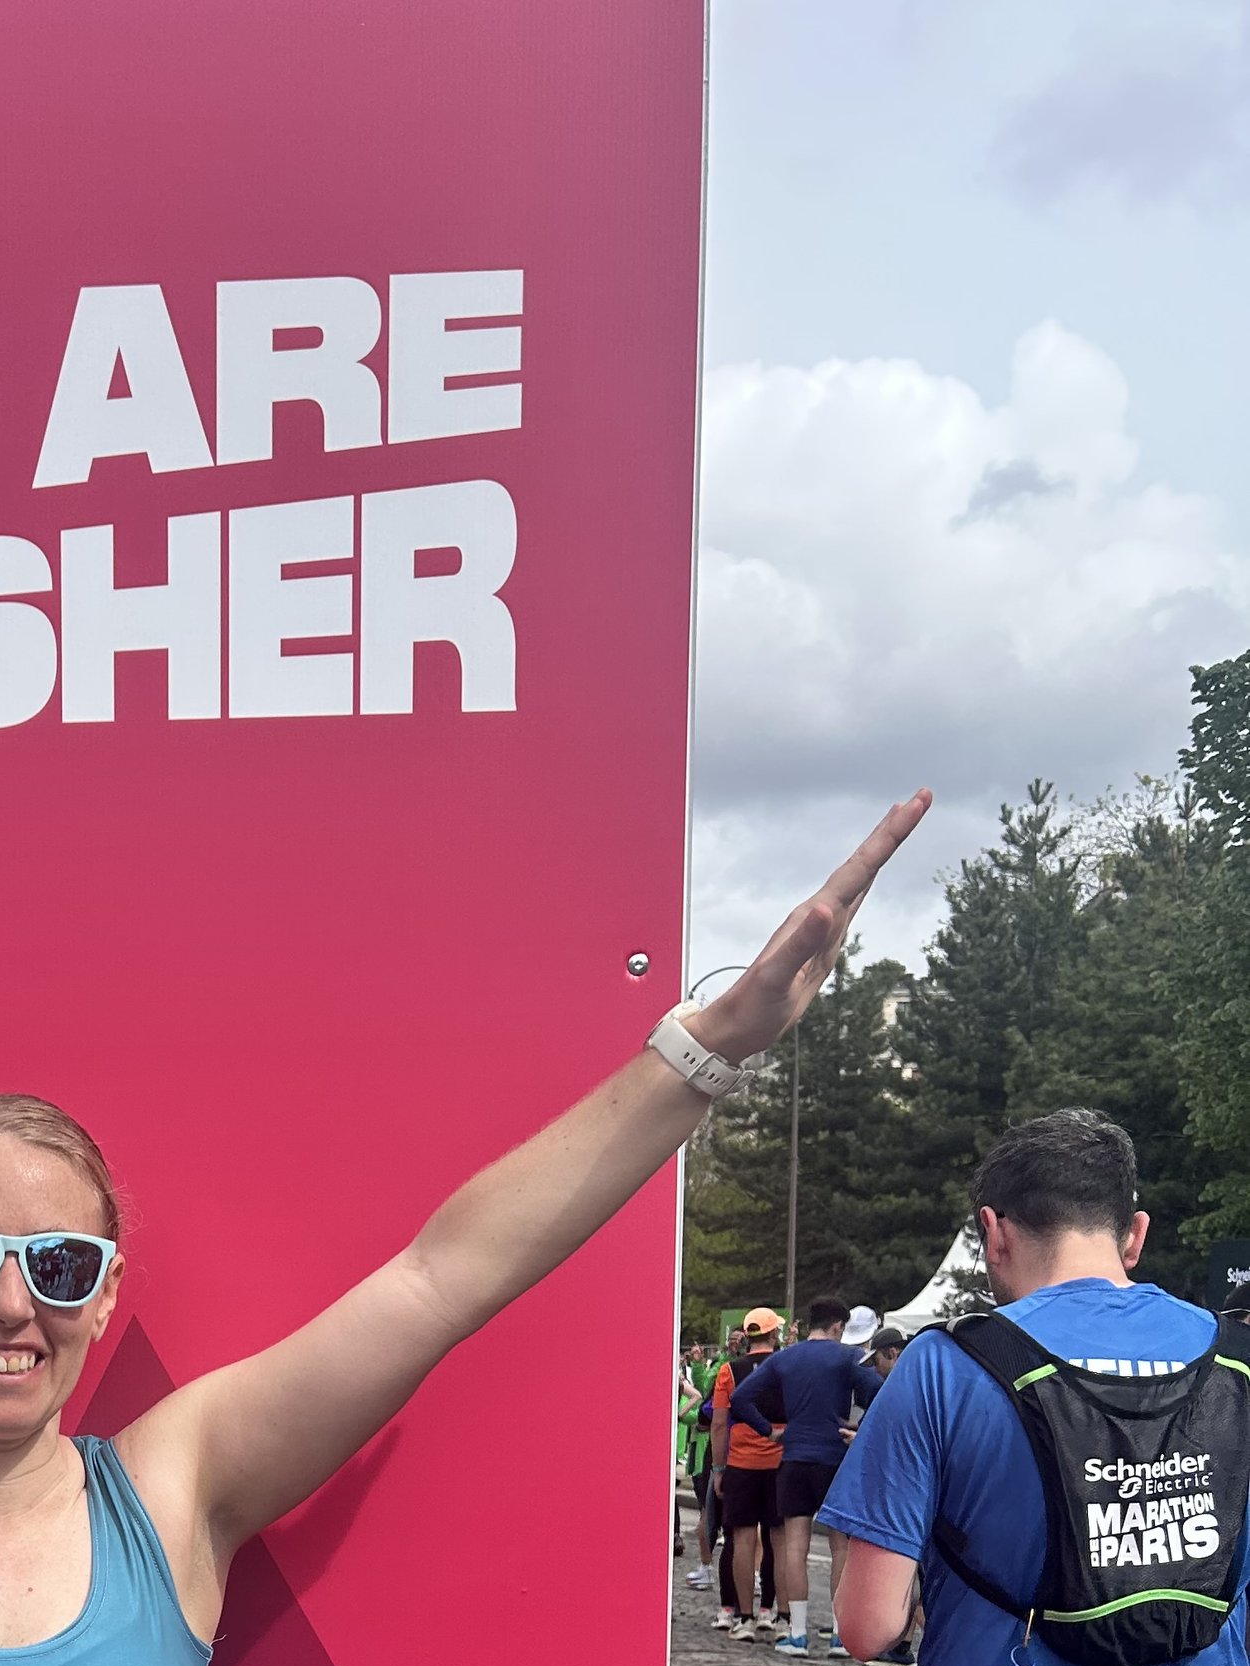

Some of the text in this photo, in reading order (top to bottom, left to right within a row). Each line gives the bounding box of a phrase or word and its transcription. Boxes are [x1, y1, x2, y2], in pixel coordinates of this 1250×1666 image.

[32, 269, 524, 489] ARE
[1084, 1451, 1211, 1482] Schneider
[1145, 1474, 1210, 1495] Electric
[1087, 1492, 1215, 1539] MARATHON
[1100, 1513, 1220, 1567] PARIS
